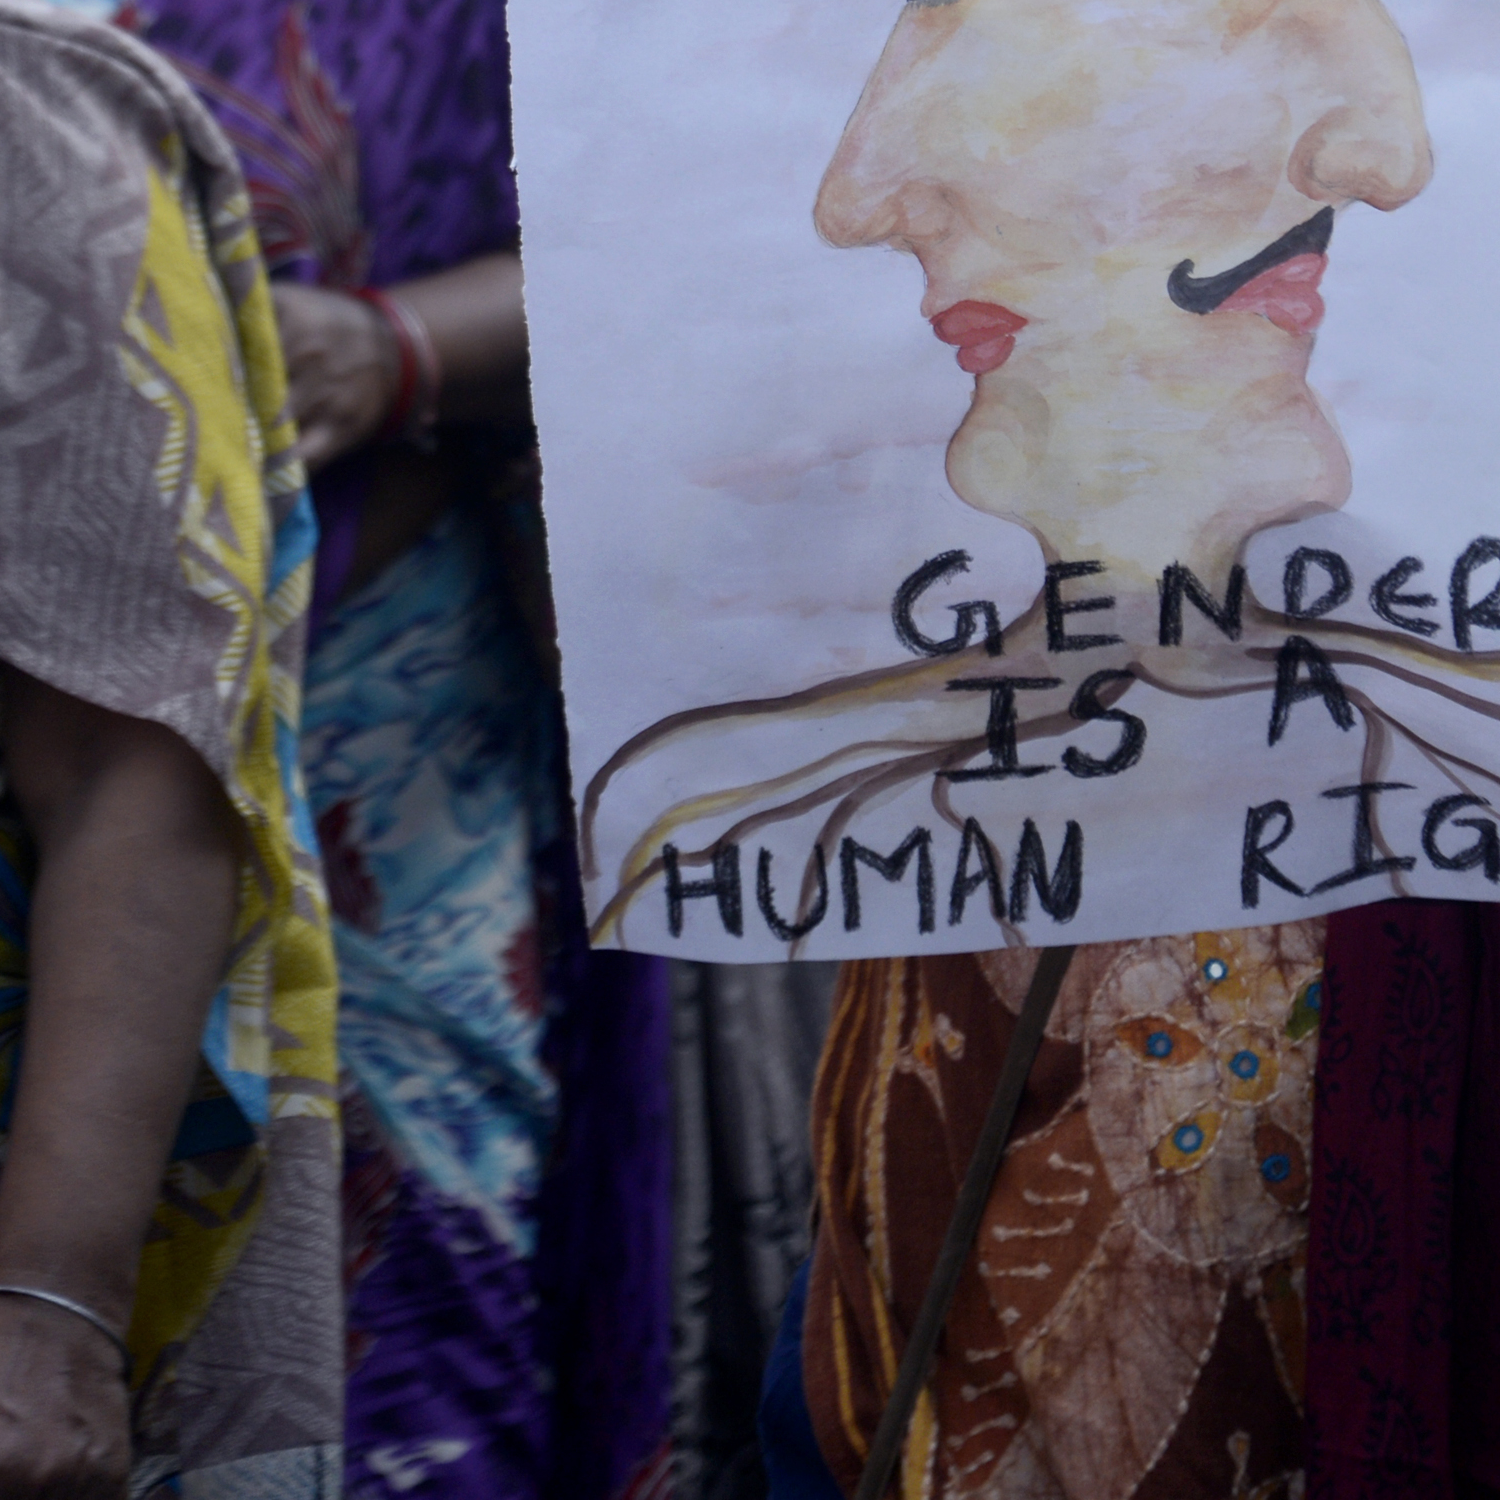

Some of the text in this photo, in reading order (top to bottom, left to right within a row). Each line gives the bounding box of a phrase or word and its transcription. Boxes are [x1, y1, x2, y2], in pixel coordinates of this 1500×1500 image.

[938, 636, 1356, 779] IS A
[665, 818, 1082, 938] HUMAN
